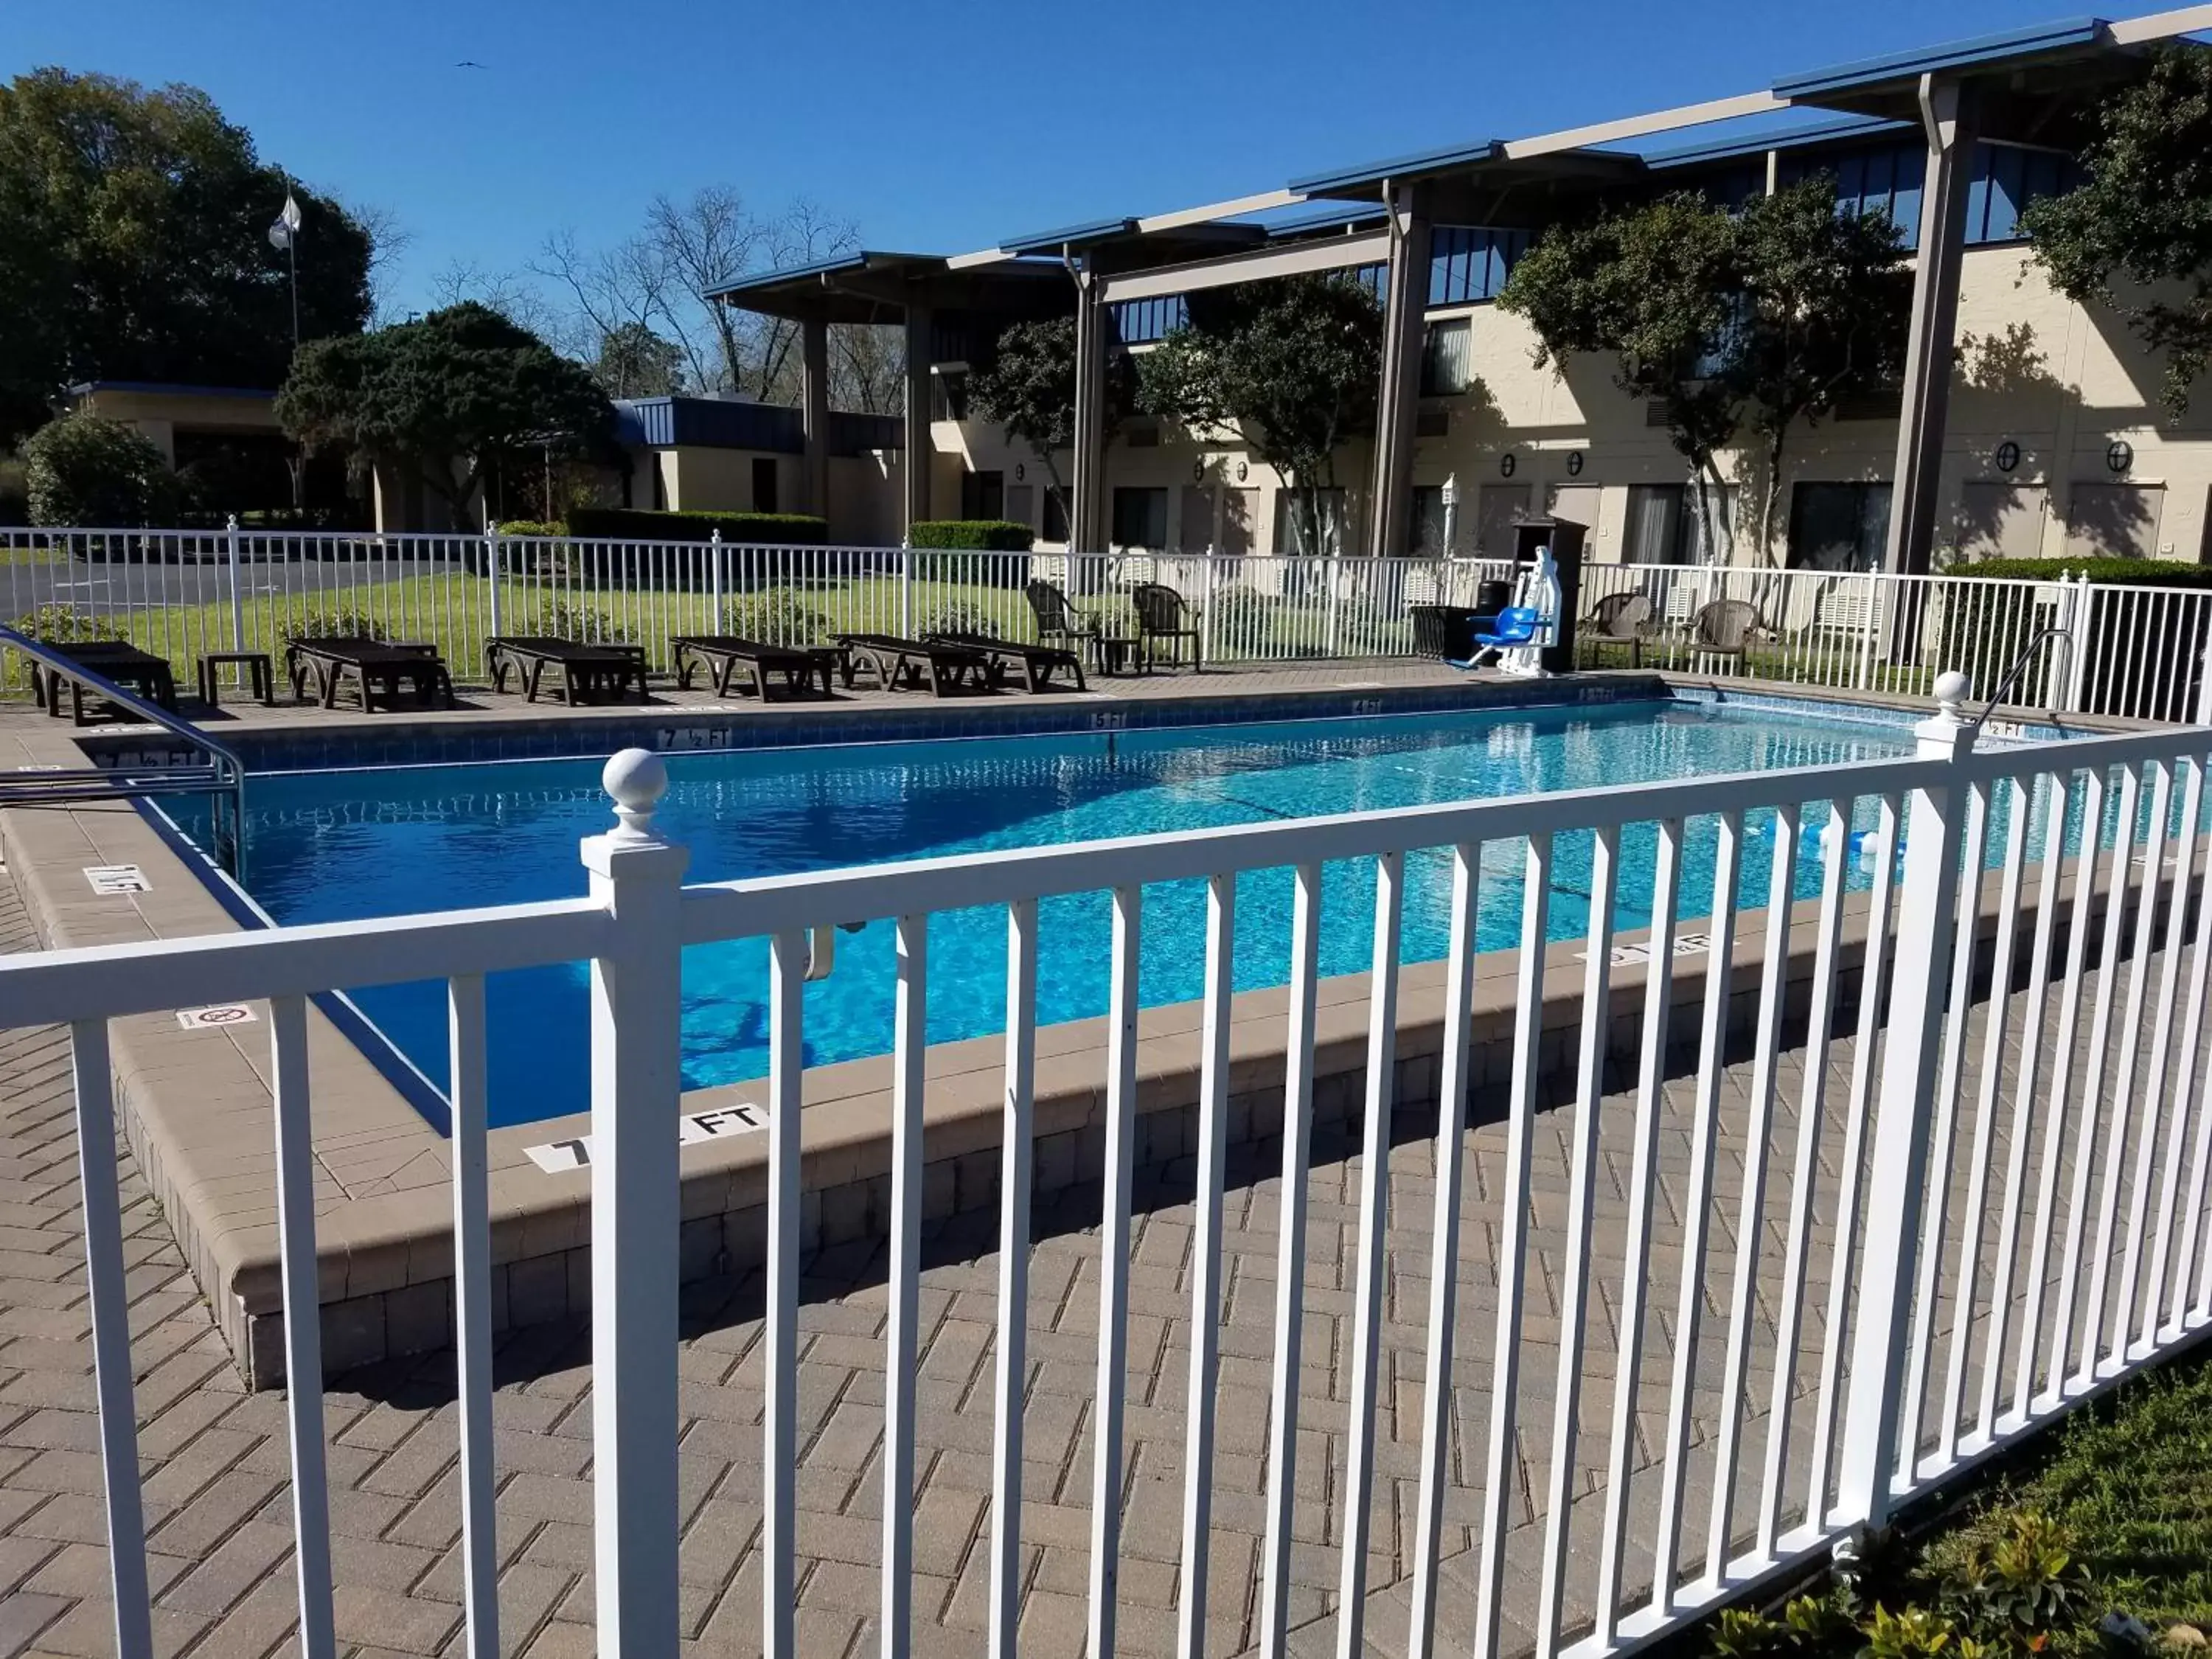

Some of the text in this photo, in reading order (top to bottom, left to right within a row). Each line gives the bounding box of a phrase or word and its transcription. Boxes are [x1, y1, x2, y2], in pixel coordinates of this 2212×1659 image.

[665, 728, 676, 747] 7
[709, 728, 729, 747] FT
[2005, 720, 2022, 737] FT
[551, 1107, 759, 1166] 7 FT
